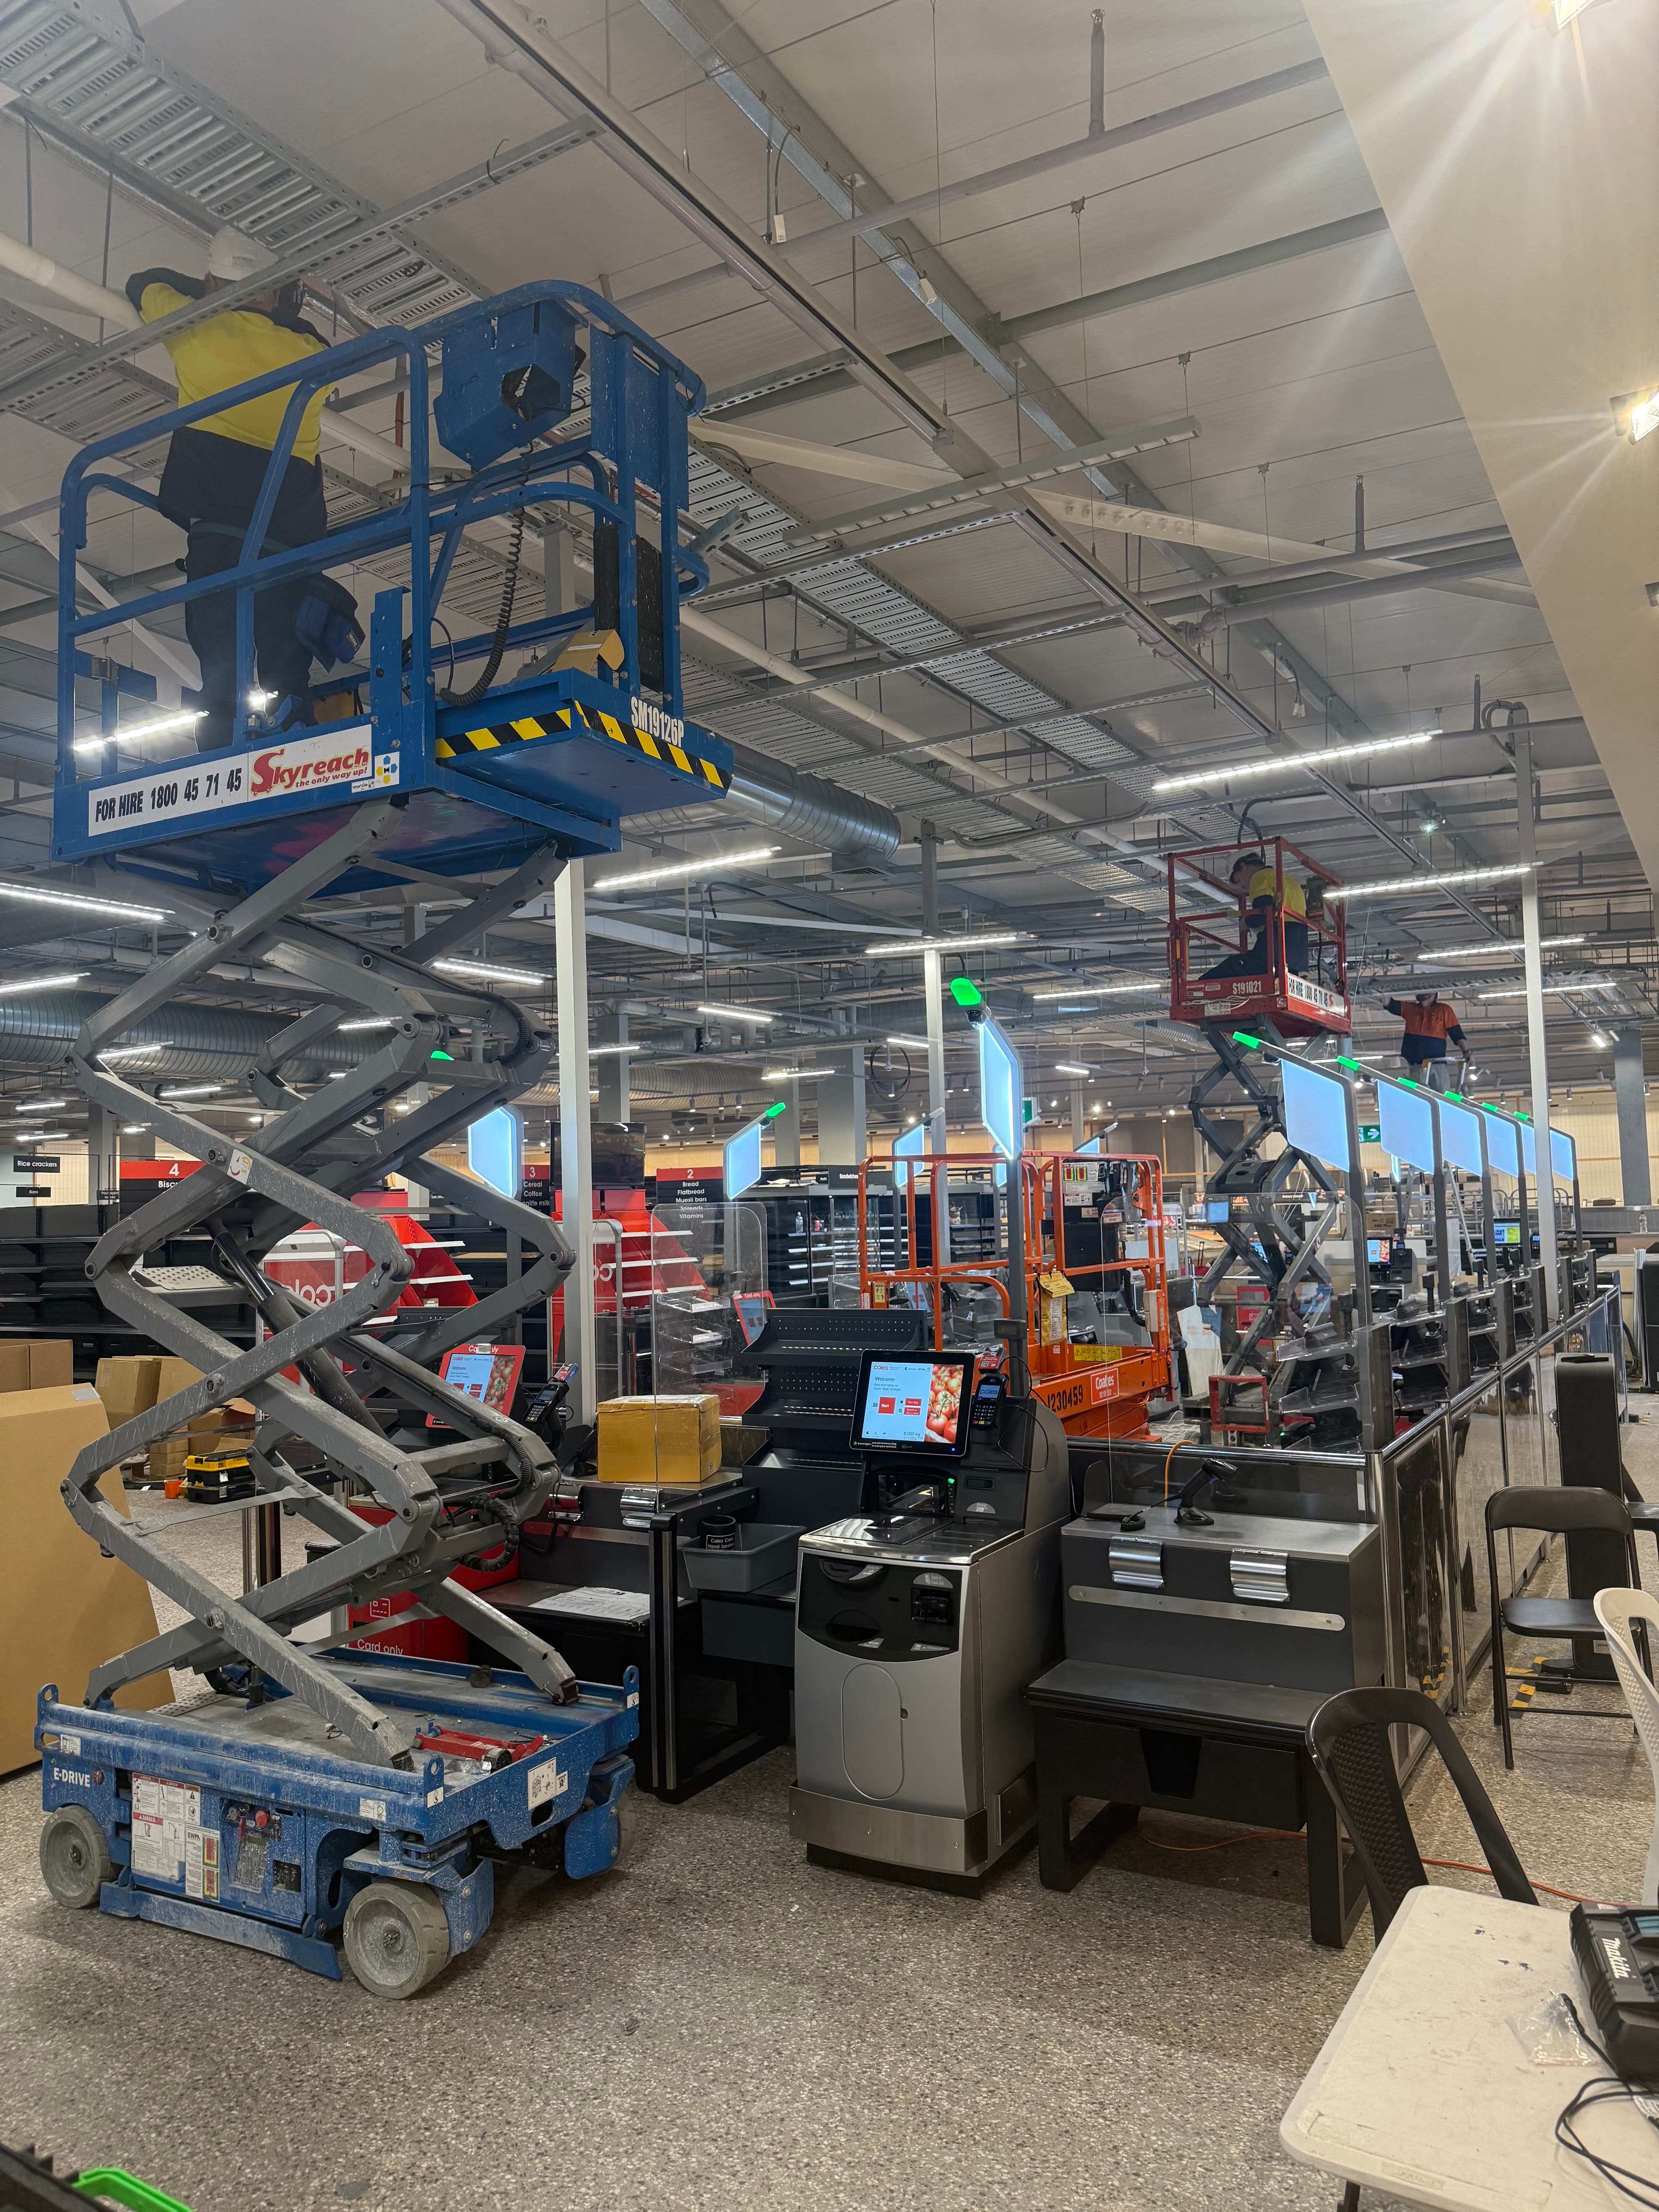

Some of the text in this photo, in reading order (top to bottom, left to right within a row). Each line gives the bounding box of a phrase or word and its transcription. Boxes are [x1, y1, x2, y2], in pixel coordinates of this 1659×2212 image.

[631, 696, 684, 748] SM19126P
[250, 748, 370, 795] Skyreach
[311, 775, 330, 786] only
[332, 770, 351, 782] way
[353, 766, 367, 777] up!
[95, 768, 242, 823] FOR HIRE 1800 45 71 45
[1232, 980, 1262, 995] S191021
[1313, 987, 1317, 1003] 45
[1319, 990, 1322, 1005] 71
[1324, 992, 1328, 1007] 45
[169, 1163, 180, 1176] 4
[529, 1166, 536, 1178] 3
[687, 1169, 694, 1179] 2
[1095, 1375, 1114, 1390] Coates
[357, 1639, 403, 1656] Card only
[54, 1767, 90, 1788] E-DRIVE
